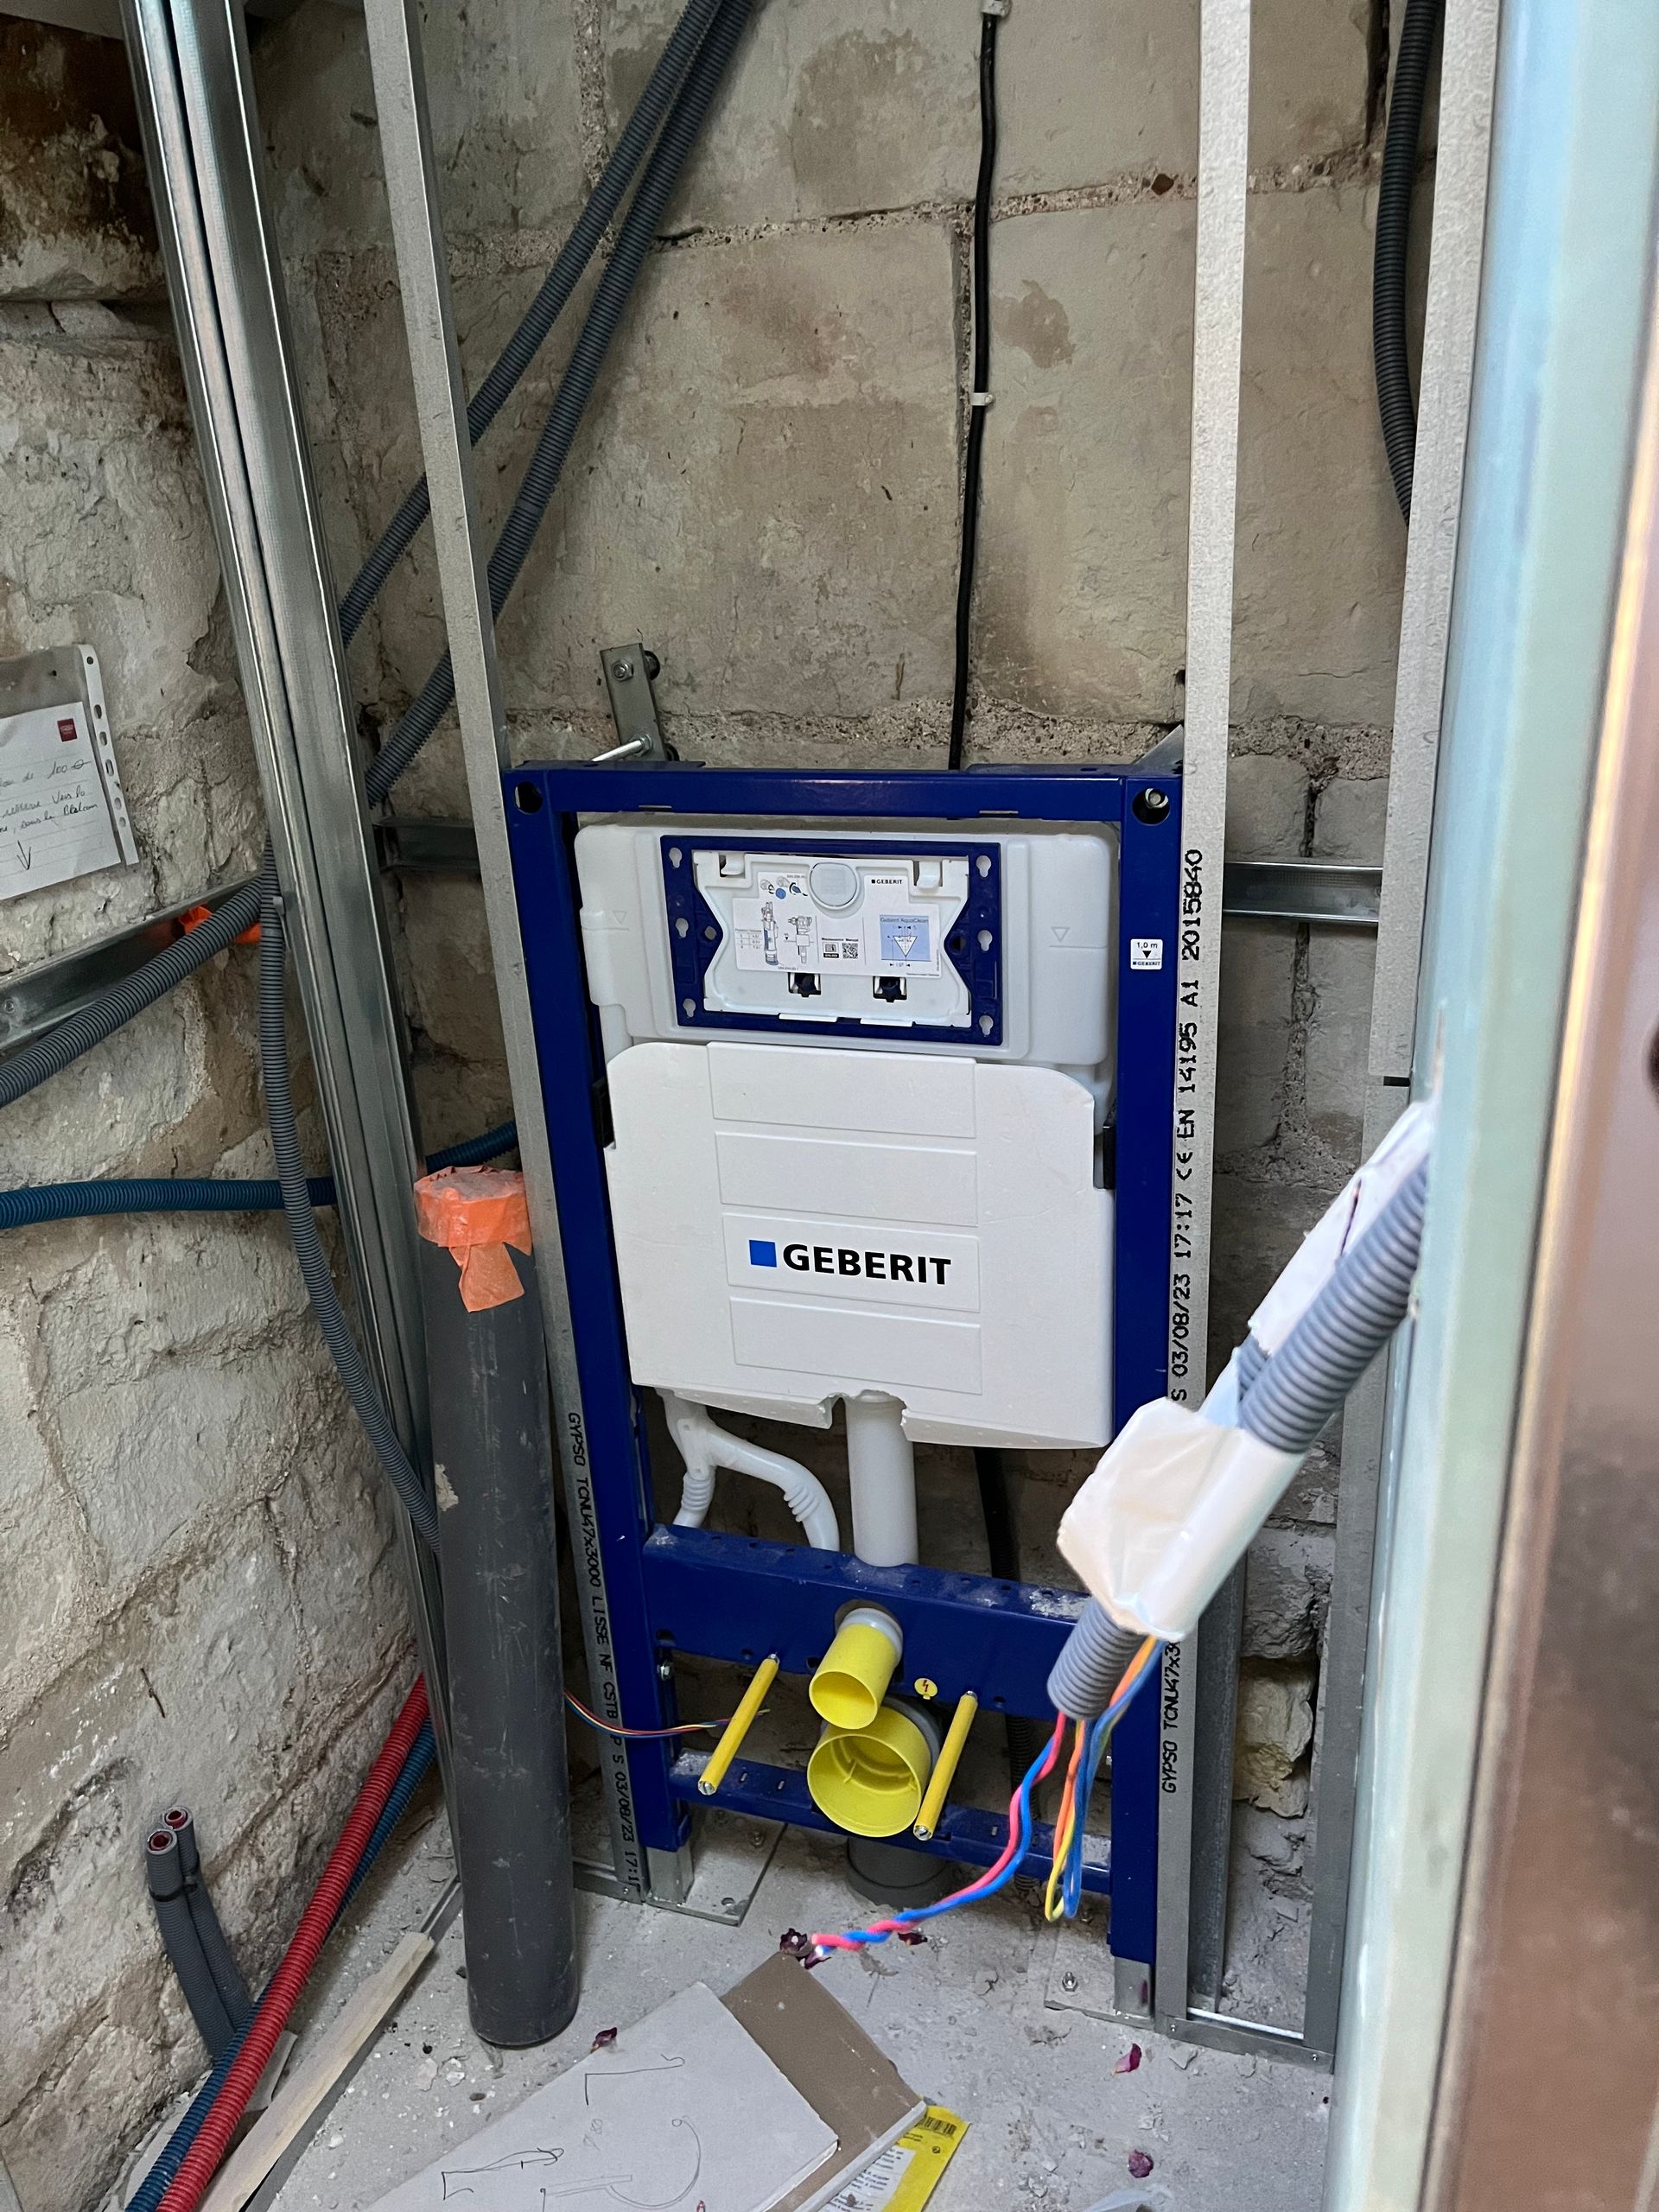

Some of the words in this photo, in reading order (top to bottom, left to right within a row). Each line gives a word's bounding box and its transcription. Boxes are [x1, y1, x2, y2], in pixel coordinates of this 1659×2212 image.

[1181, 849, 1203, 962] 2015840
[1178, 1022, 1198, 1093] 14195
[1176, 1109, 1195, 1139] EN
[1174, 1193, 1193, 1259] 17:17
[783, 1243, 951, 1285] GEBERIT
[1172, 1273, 1191, 1377] 03/08/23
[569, 1412, 585, 1466] GYPSO
[592, 1596, 610, 1646] LISSE
[599, 1653, 613, 1674] NF
[604, 1681, 619, 1719] CSTB
[1161, 1739, 1178, 1794] GYPSO
[614, 1771, 634, 1842] 03/08/23
